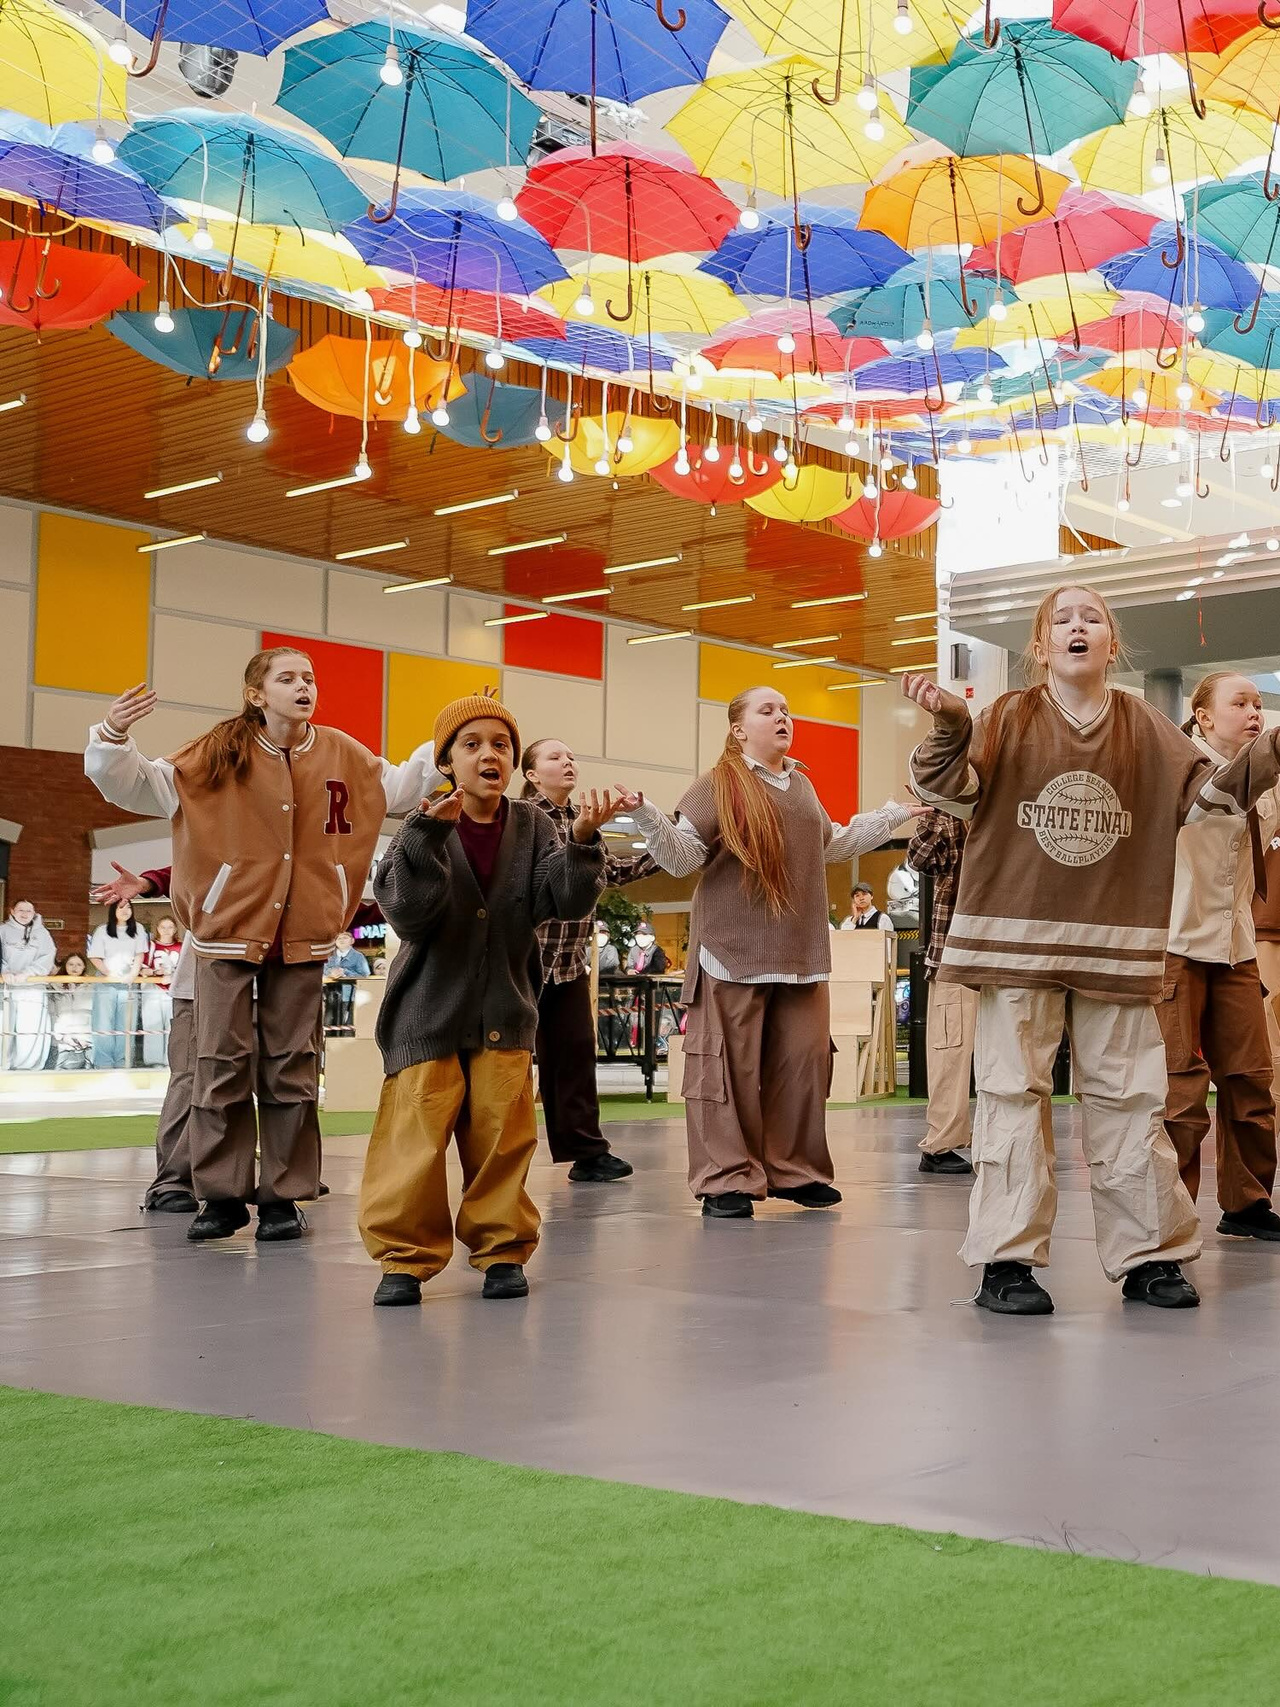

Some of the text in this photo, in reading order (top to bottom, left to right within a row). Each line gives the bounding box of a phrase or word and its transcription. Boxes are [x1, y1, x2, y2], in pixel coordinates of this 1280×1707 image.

[1046, 774, 1116, 801] COLLEGE SEASON
[324, 779, 352, 835] R
[1021, 803, 1130, 836] STATE FINAL
[1038, 830, 1058, 853] BEST
